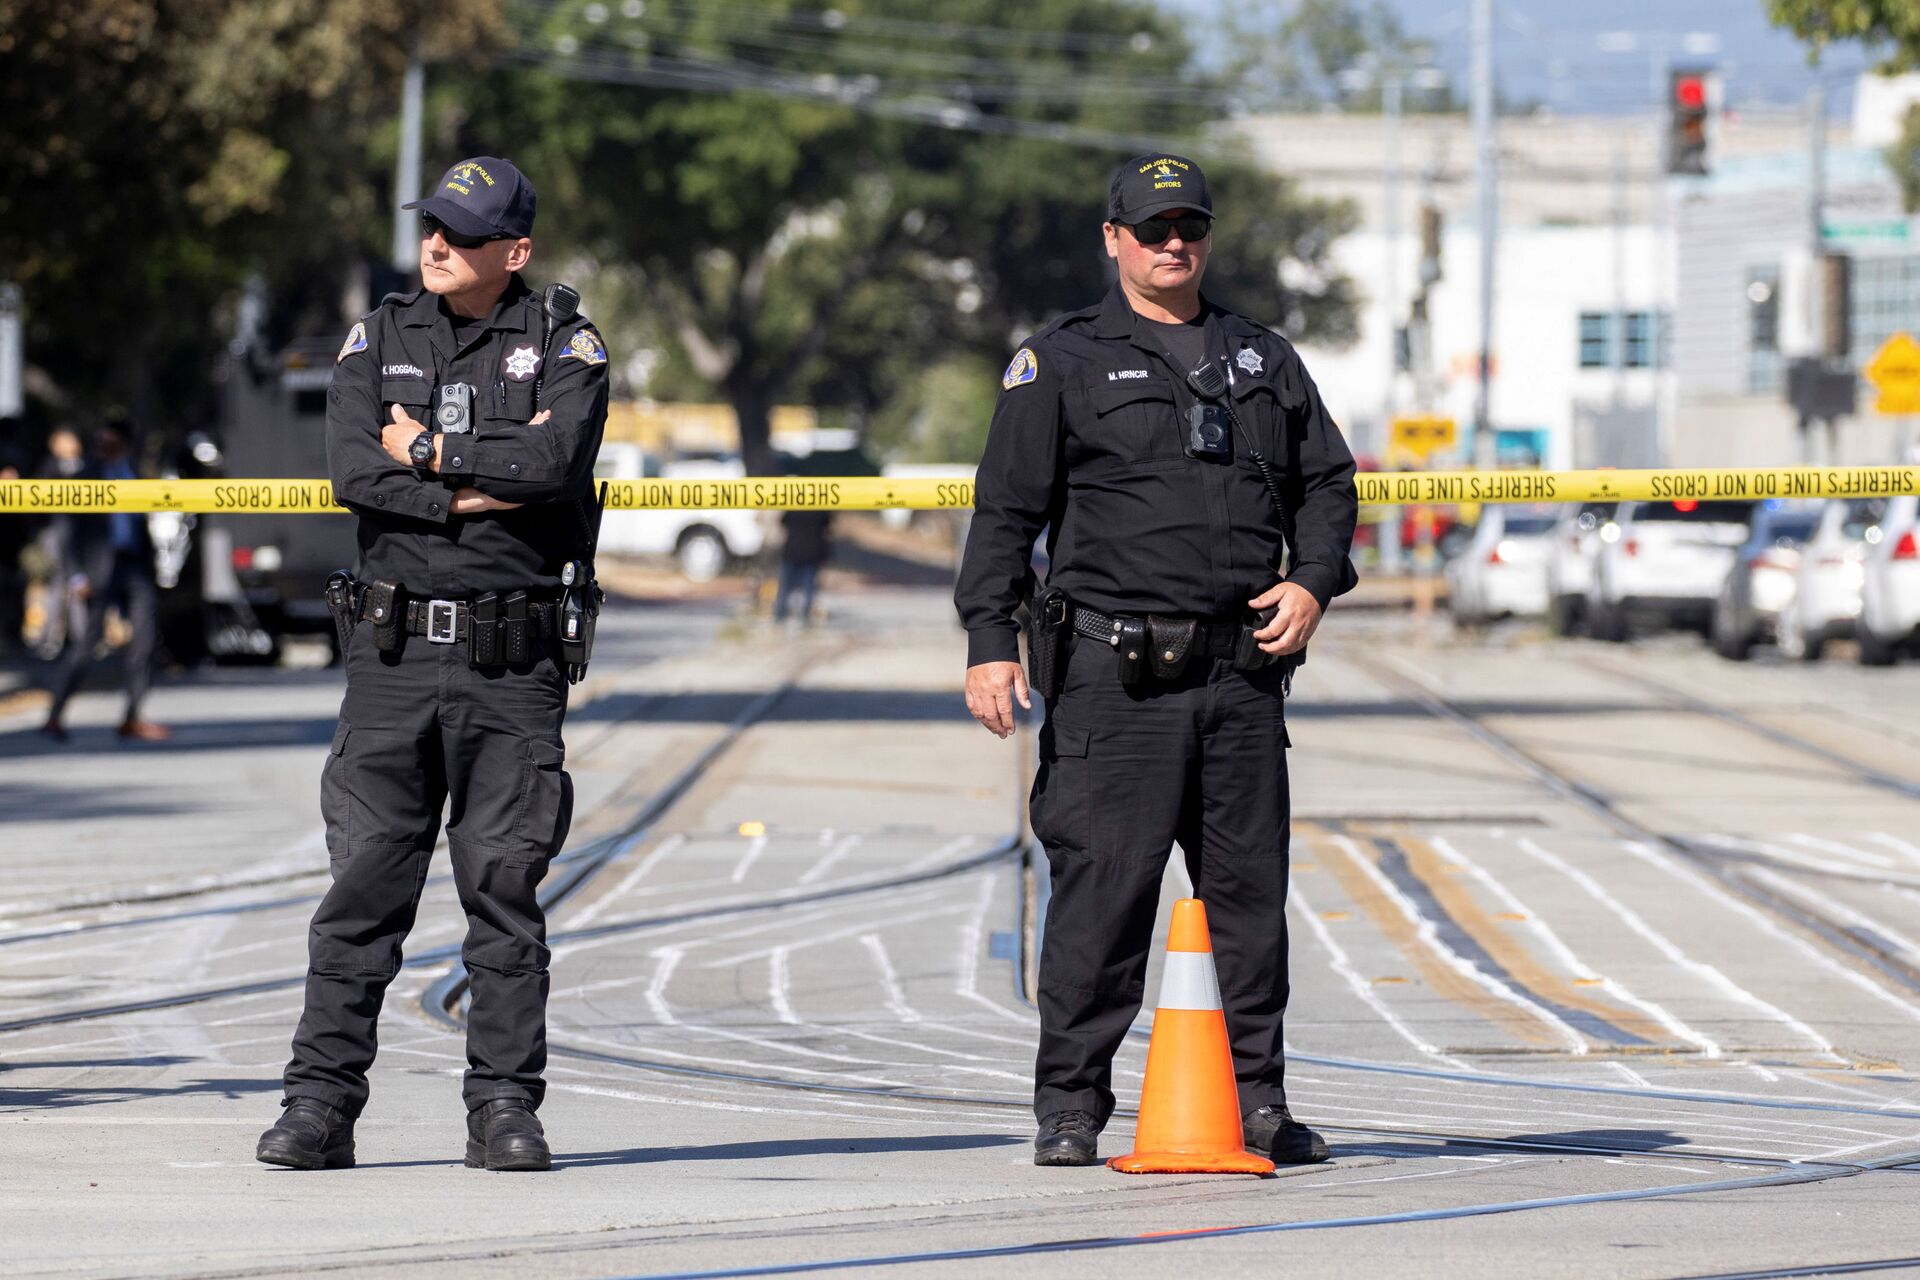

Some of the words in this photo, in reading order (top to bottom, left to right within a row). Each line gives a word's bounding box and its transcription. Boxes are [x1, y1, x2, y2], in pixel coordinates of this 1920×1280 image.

[476, 166, 495, 187] POLICE
[1139, 163, 1152, 173] SAN
[1168, 159, 1189, 171] POLICE
[446, 182, 470, 195] MOTORS
[1154, 181, 1182, 189] MOTORS
[389, 364, 424, 377] HOGGARD
[1108, 371, 1118, 381] M.
[1118, 369, 1149, 380] HRNCIR
[1358, 478, 1389, 501] NOT
[1397, 478, 1419, 501] DO
[1426, 477, 1463, 500] LINE
[1470, 476, 1556, 499] SHERIFF'S
[1651, 475, 1708, 498] CROSS
[1713, 474, 1747, 497] NOT
[1754, 473, 1777, 496] DO
[1783, 472, 1821, 495] LINE
[1827, 471, 1913, 494] SHERIFF'S
[30, 484, 117, 507] SHERIFF'S
[214, 485, 272, 508] CROSS
[278, 485, 312, 508] NOT
[640, 484, 673, 507] NOT
[681, 484, 702, 507] DO
[710, 484, 747, 507] LINE
[754, 483, 840, 506] SHERIFF'S
